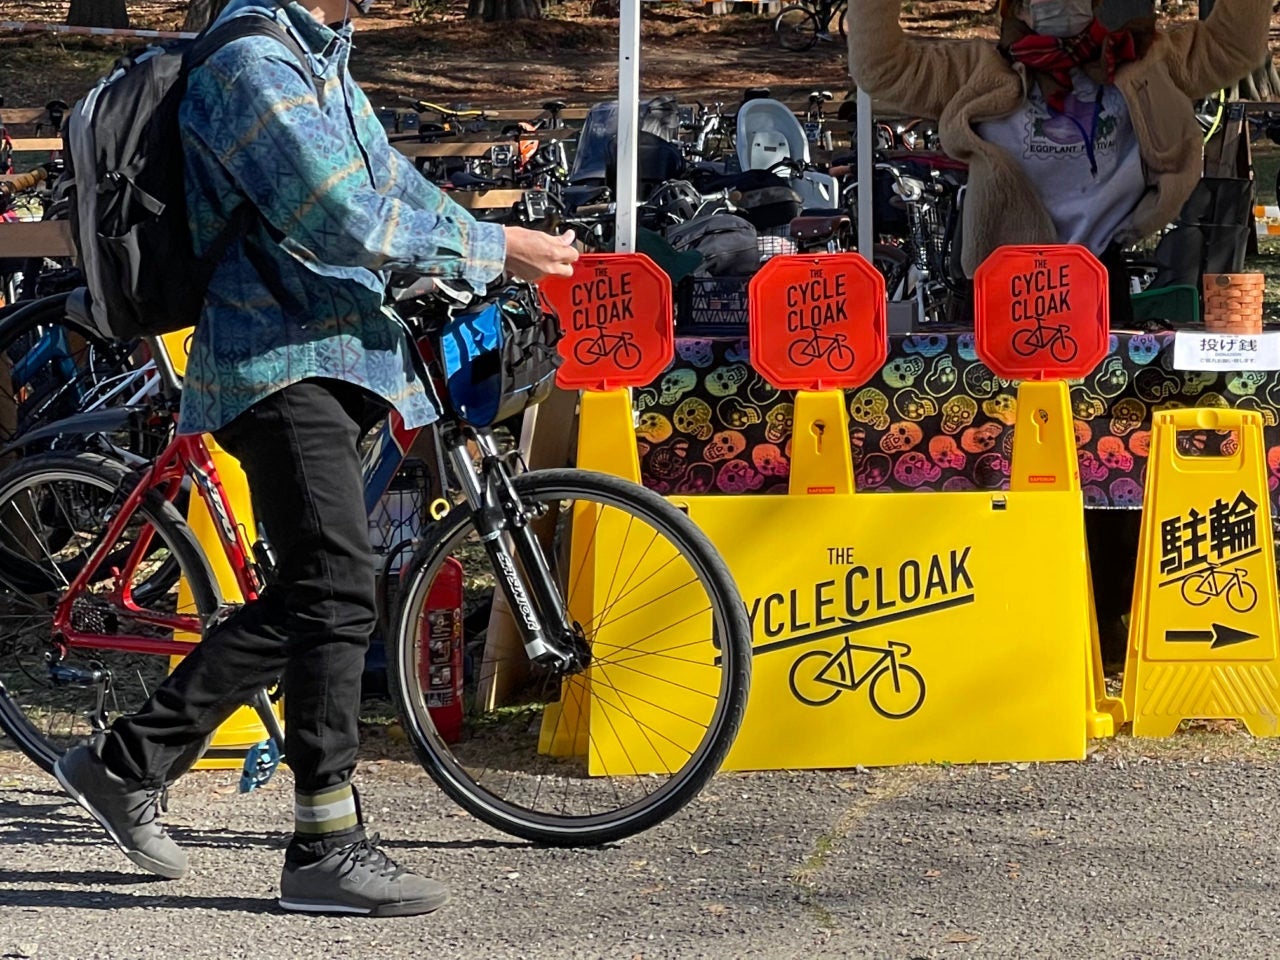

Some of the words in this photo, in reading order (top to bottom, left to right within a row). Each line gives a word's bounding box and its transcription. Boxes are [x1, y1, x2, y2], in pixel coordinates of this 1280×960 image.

[1030, 144, 1076, 153] EGGPLANT
[595, 268, 608, 277] THE
[809, 268, 823, 278] THE
[1034, 259, 1047, 269] THE
[572, 272, 632, 306] CYCLE
[786, 273, 847, 309] CYCLE
[1011, 265, 1070, 297] CYCLE
[573, 297, 634, 331] CLOAK
[787, 299, 848, 332] CLOAK
[1012, 290, 1071, 322] CLOAK
[1200, 338, 1258, 352] 投げ銭
[1160, 490, 1258, 576] 駐輪
[827, 547, 854, 565] THE
